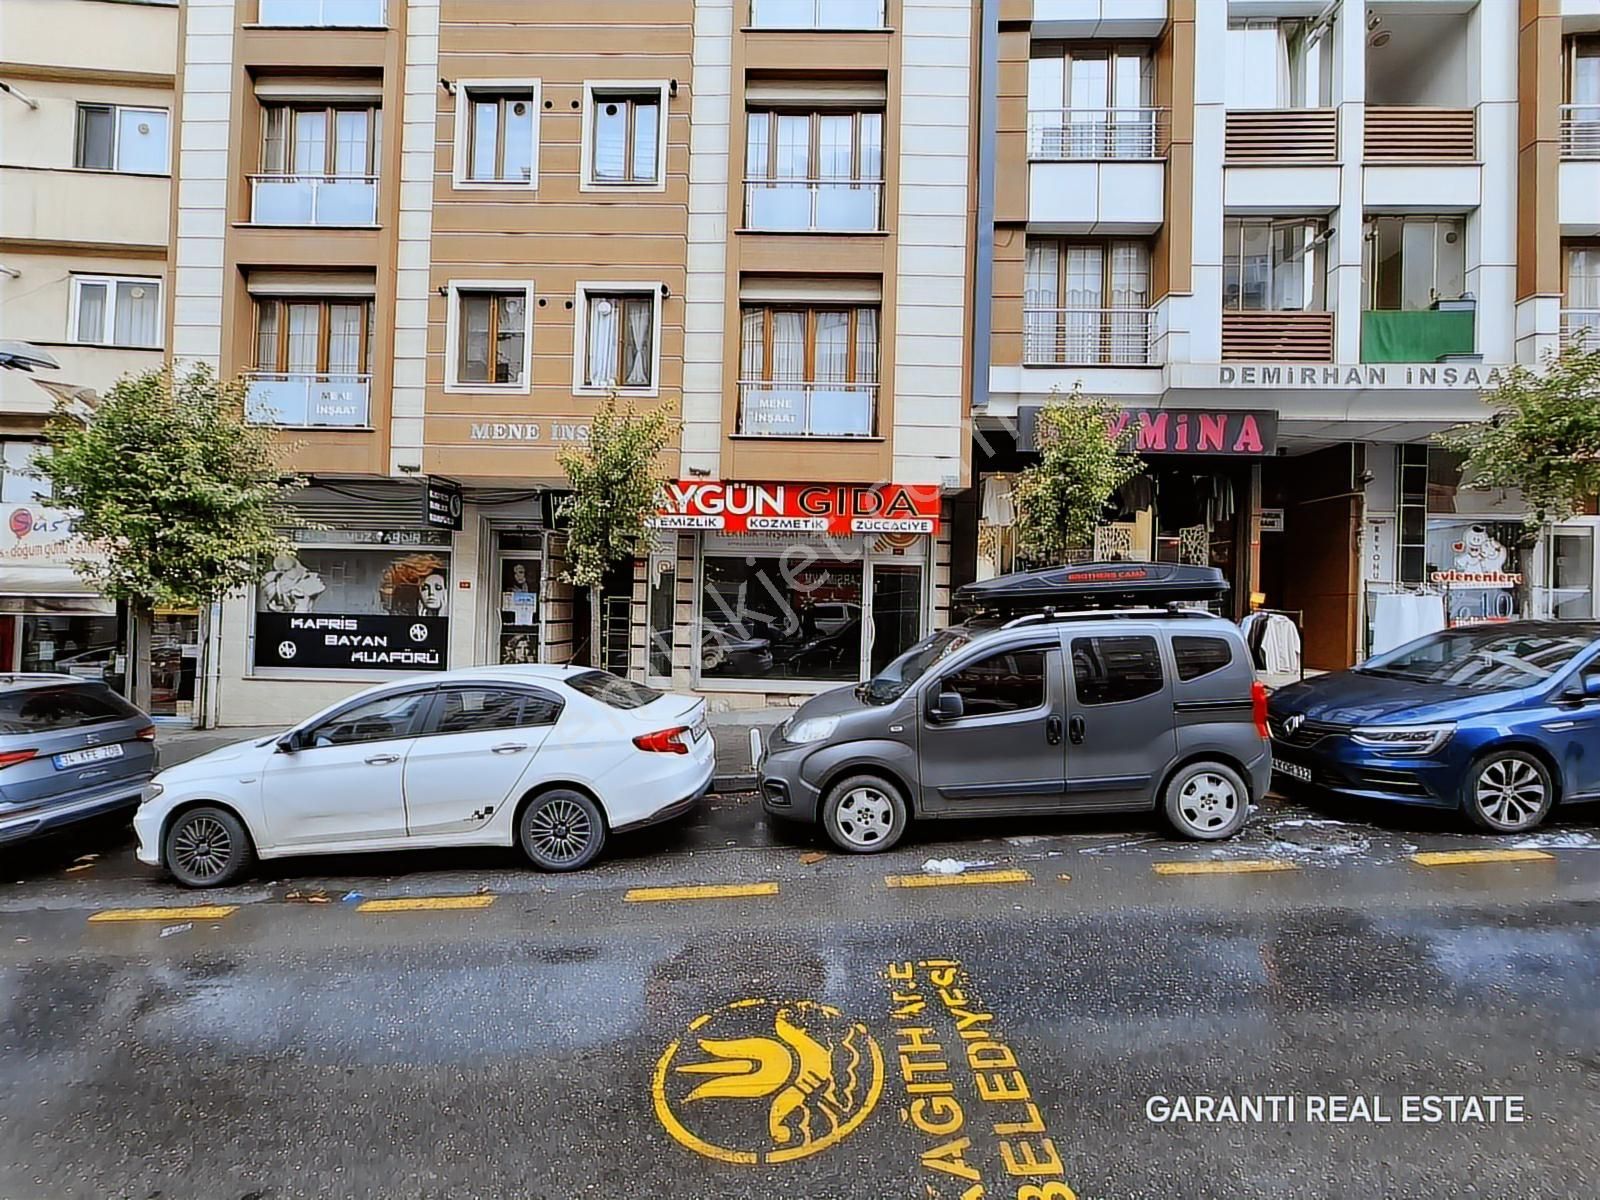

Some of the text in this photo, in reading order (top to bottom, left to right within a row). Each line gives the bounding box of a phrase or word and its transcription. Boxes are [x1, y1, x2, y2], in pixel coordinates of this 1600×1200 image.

[470, 423, 540, 440] MENE
[797, 486, 920, 517] GIDA
[290, 615, 358, 631] KAPRİS
[324, 634, 388, 647] BAYAN
